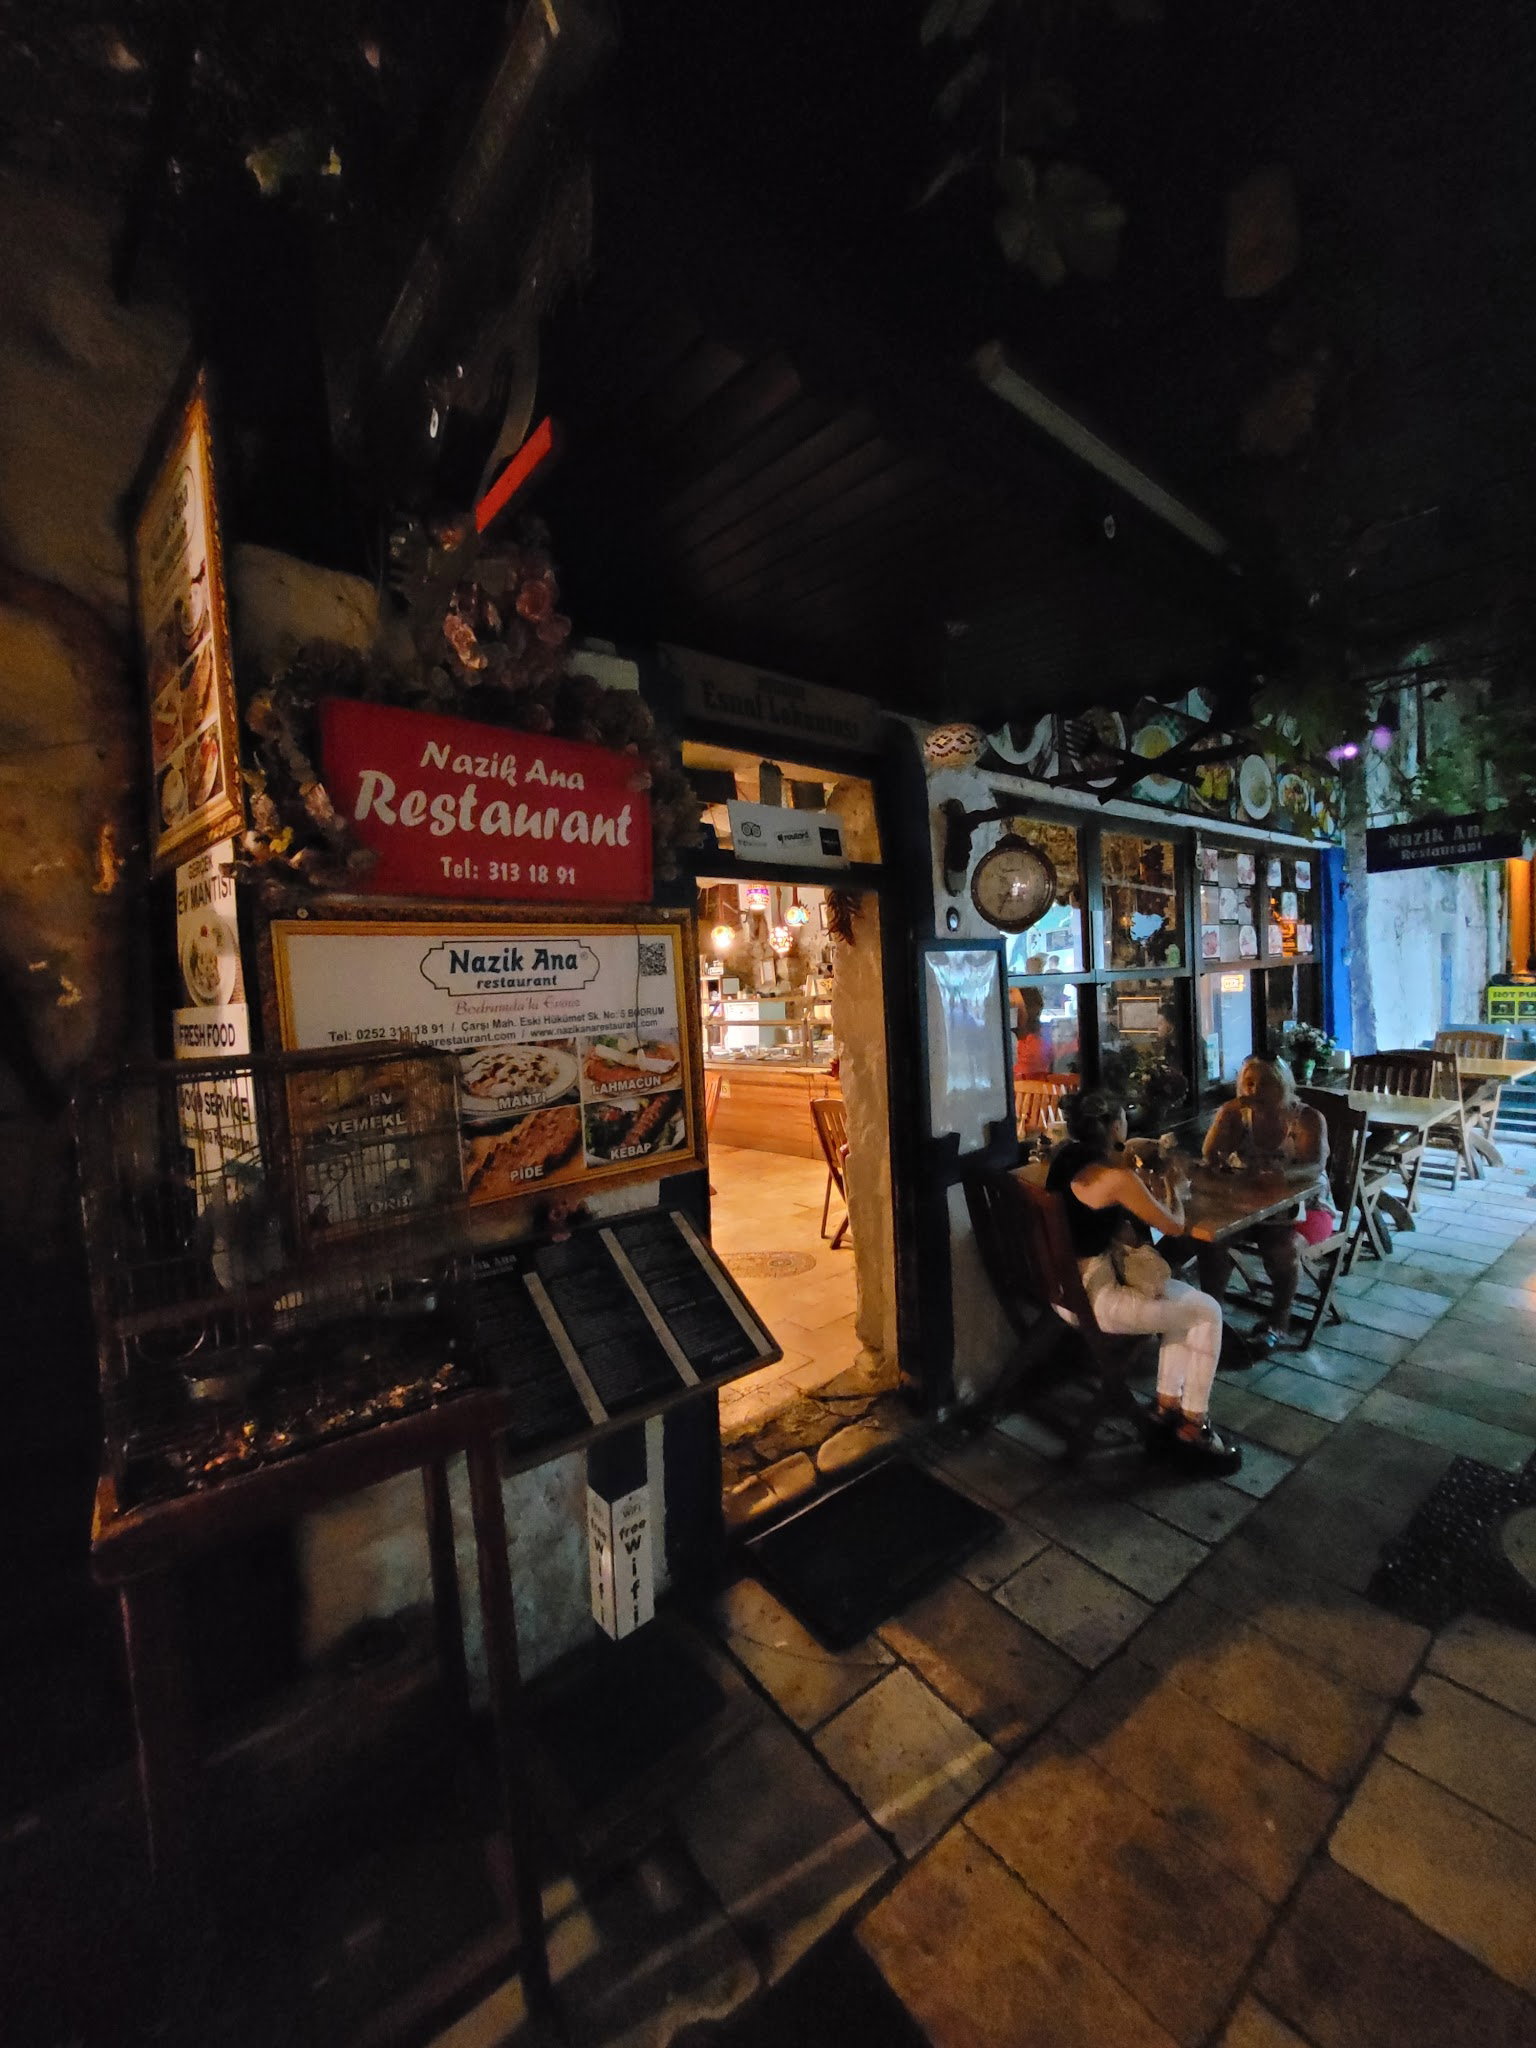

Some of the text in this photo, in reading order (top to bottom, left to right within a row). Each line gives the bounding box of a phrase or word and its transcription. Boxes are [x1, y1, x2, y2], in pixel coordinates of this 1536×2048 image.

[420, 741, 585, 791] Nazik Ana
[354, 769, 632, 847] Restaurant
[1387, 825, 1481, 849] Nazik An
[1401, 841, 1482, 861] Restaurant
[440, 857, 576, 886] Tel: 313 18 91
[449, 947, 578, 974] Nazik Ana
[476, 975, 557, 990] restaurant
[179, 1023, 236, 1048] FRESH FOOD
[328, 1031, 352, 1043] Tel:
[356, 1028, 386, 1041] 0252
[416, 1024, 429, 1036] 18
[431, 1023, 444, 1034] 91
[493, 1019, 516, 1030] Mah.
[520, 1016, 542, 1027] Eski
[544, 1012, 585, 1025] Hükümet
[628, 1006, 665, 1018] BODRUM
[592, 1076, 662, 1096] LAHMACUN
[326, 1112, 408, 1136] YEMEKL
[610, 1143, 653, 1161] KEBAP
[619, 1518, 647, 1541] free
